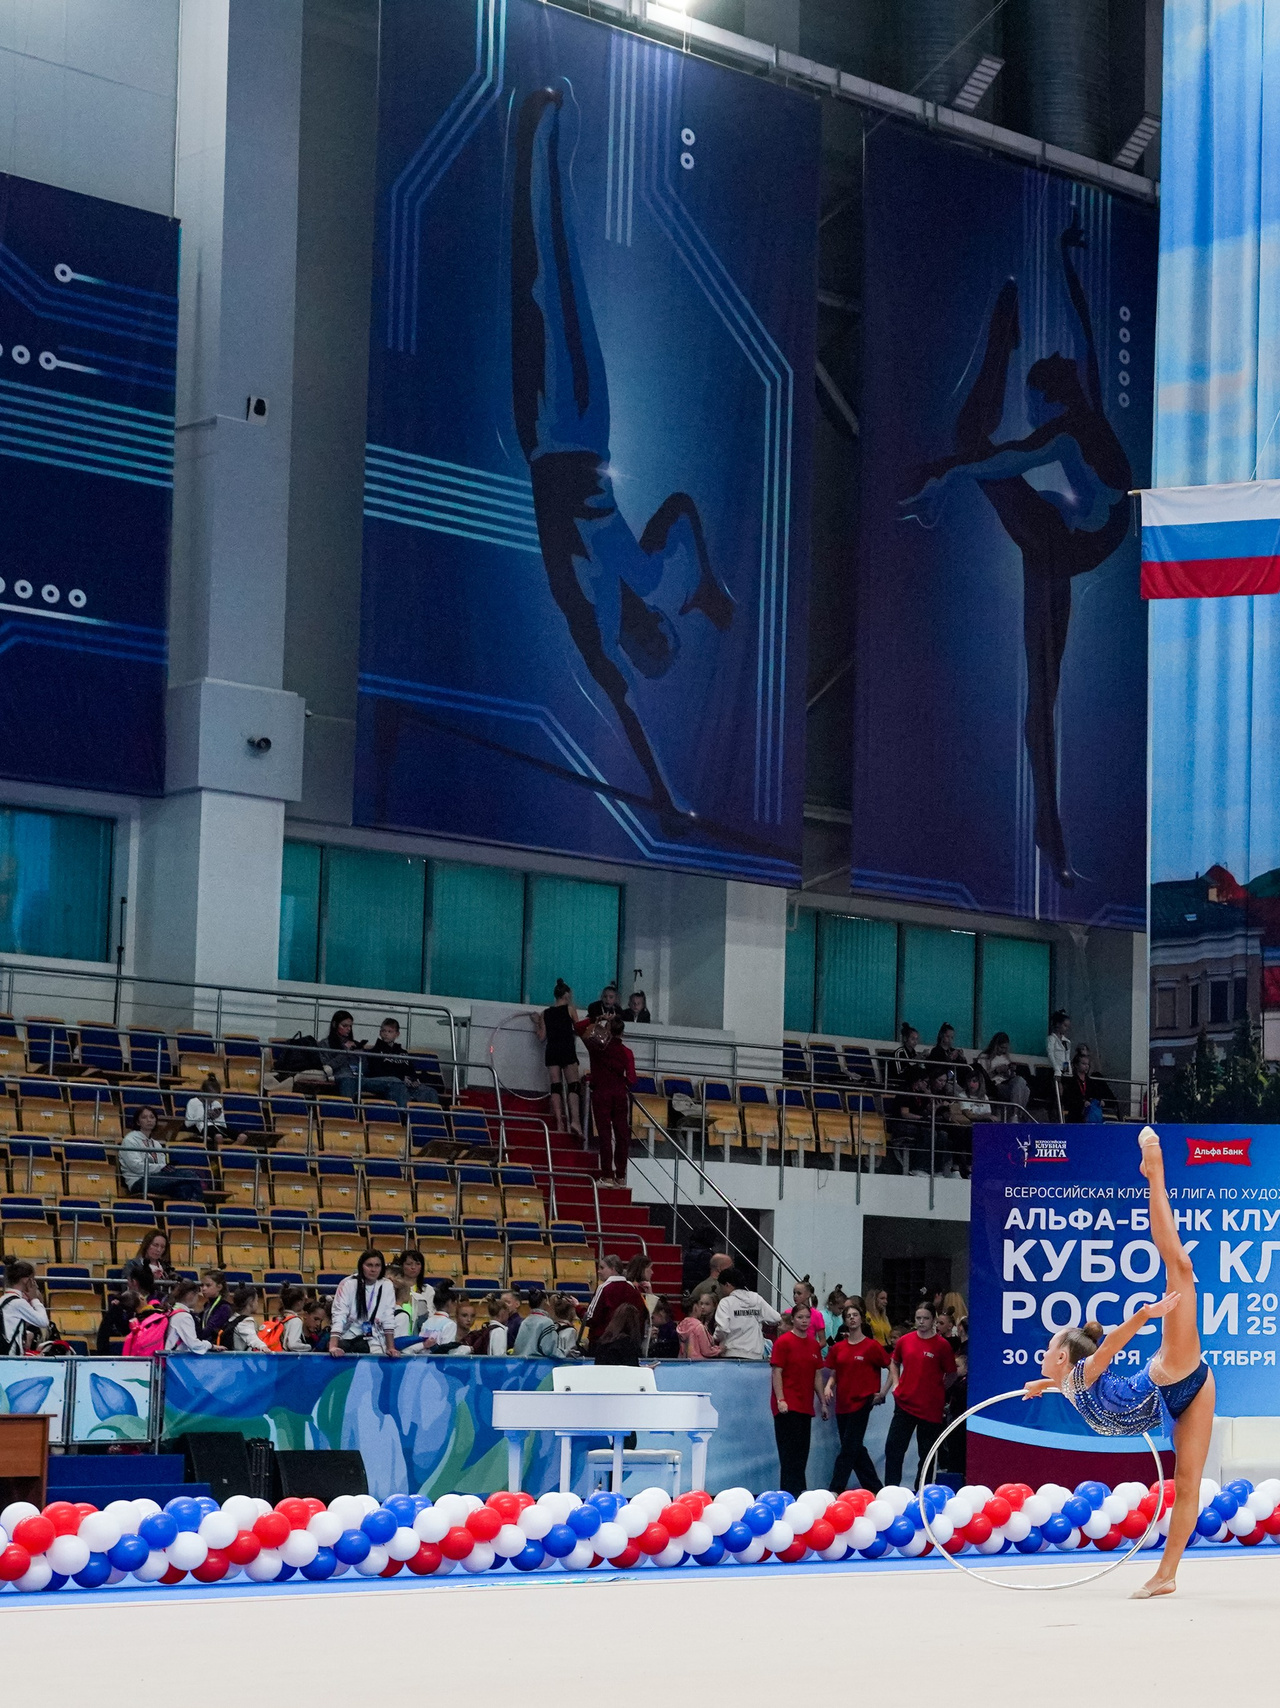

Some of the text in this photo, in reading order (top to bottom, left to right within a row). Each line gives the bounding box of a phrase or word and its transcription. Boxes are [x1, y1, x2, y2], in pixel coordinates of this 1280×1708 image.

[1035, 1149, 1067, 1158] ЛИГА
[1194, 1147, 1244, 1158] Альфа Банк
[1004, 1185, 1114, 1199] ВСЕРОССИЙСКАЯ
[1117, 1187, 1178, 1199] КЛУБЯ
[1181, 1188, 1216, 1199] ЛИГА
[1219, 1188, 1238, 1200] ПО
[1004, 1207, 1213, 1231] АЛЬФА-БНК
[1246, 1293, 1279, 1312] 20
[1002, 1290, 1239, 1336] РОССИ
[1246, 1316, 1278, 1336] 25
[1002, 1349, 1028, 1365] 30
[1200, 1349, 1276, 1366] КТЯБРЯ
